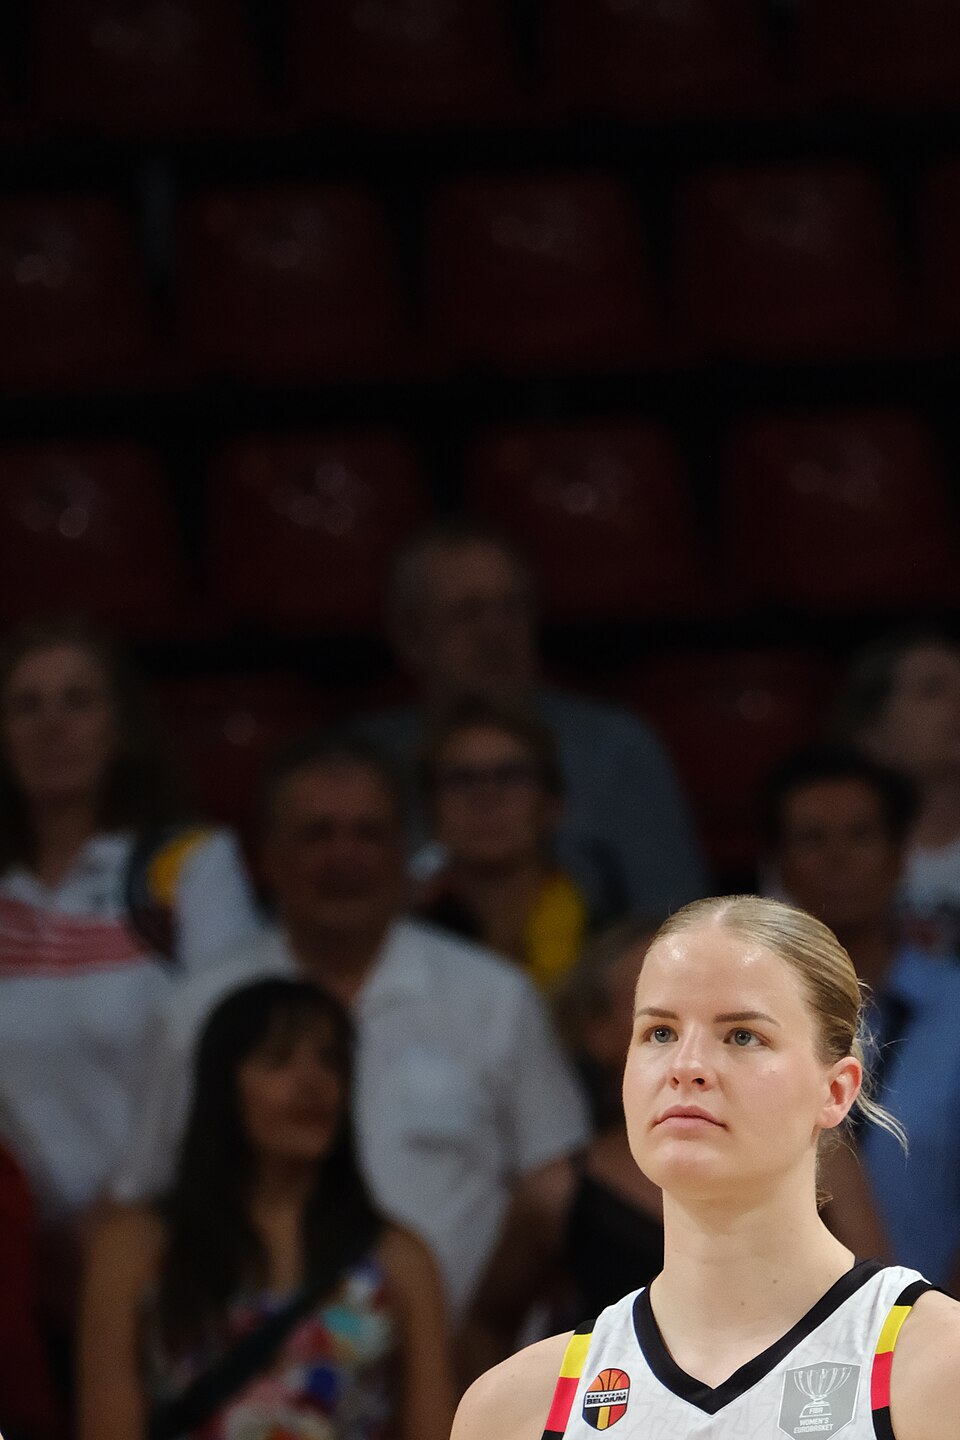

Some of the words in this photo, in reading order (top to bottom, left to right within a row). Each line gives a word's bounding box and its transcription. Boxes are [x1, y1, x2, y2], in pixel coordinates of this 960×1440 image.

[586, 1395, 626, 1405] BELGIUM
[800, 1417, 829, 1426] WOMEN'S
[793, 1423, 834, 1434] EUROBASKET
